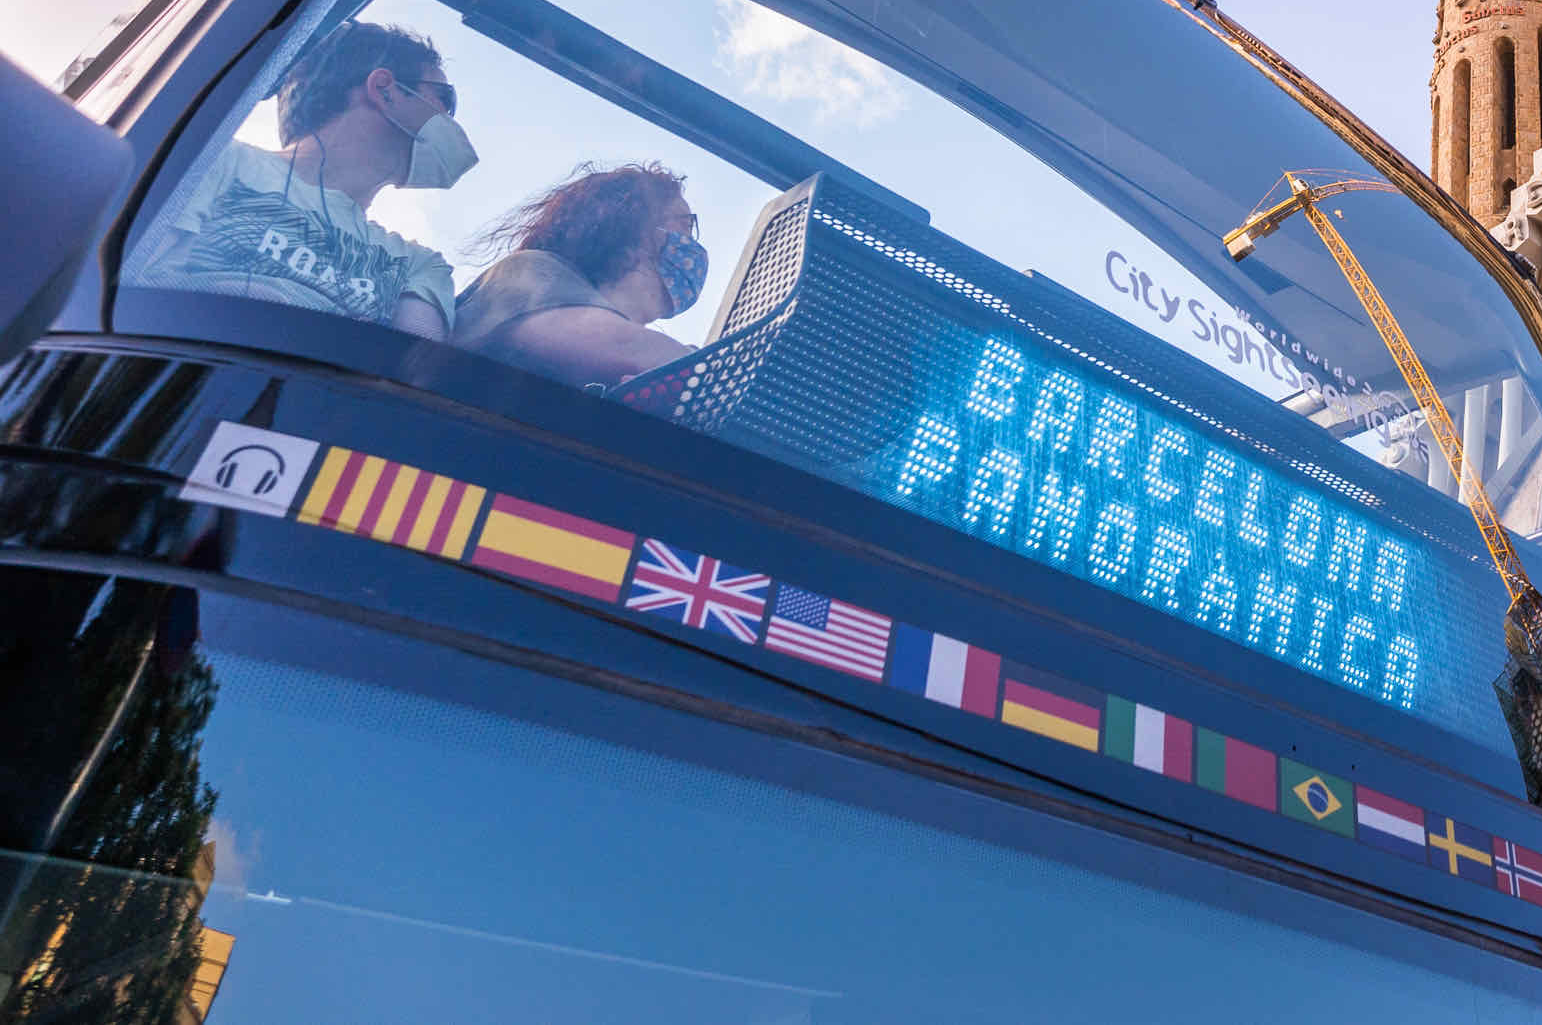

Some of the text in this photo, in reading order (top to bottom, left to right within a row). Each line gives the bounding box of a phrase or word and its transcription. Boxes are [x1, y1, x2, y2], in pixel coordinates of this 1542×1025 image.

[257, 228, 377, 308] ROAR
[1104, 249, 1181, 324] City
[1235, 305, 1358, 387] Worldwide
[966, 336, 1410, 613] BARCELONA
